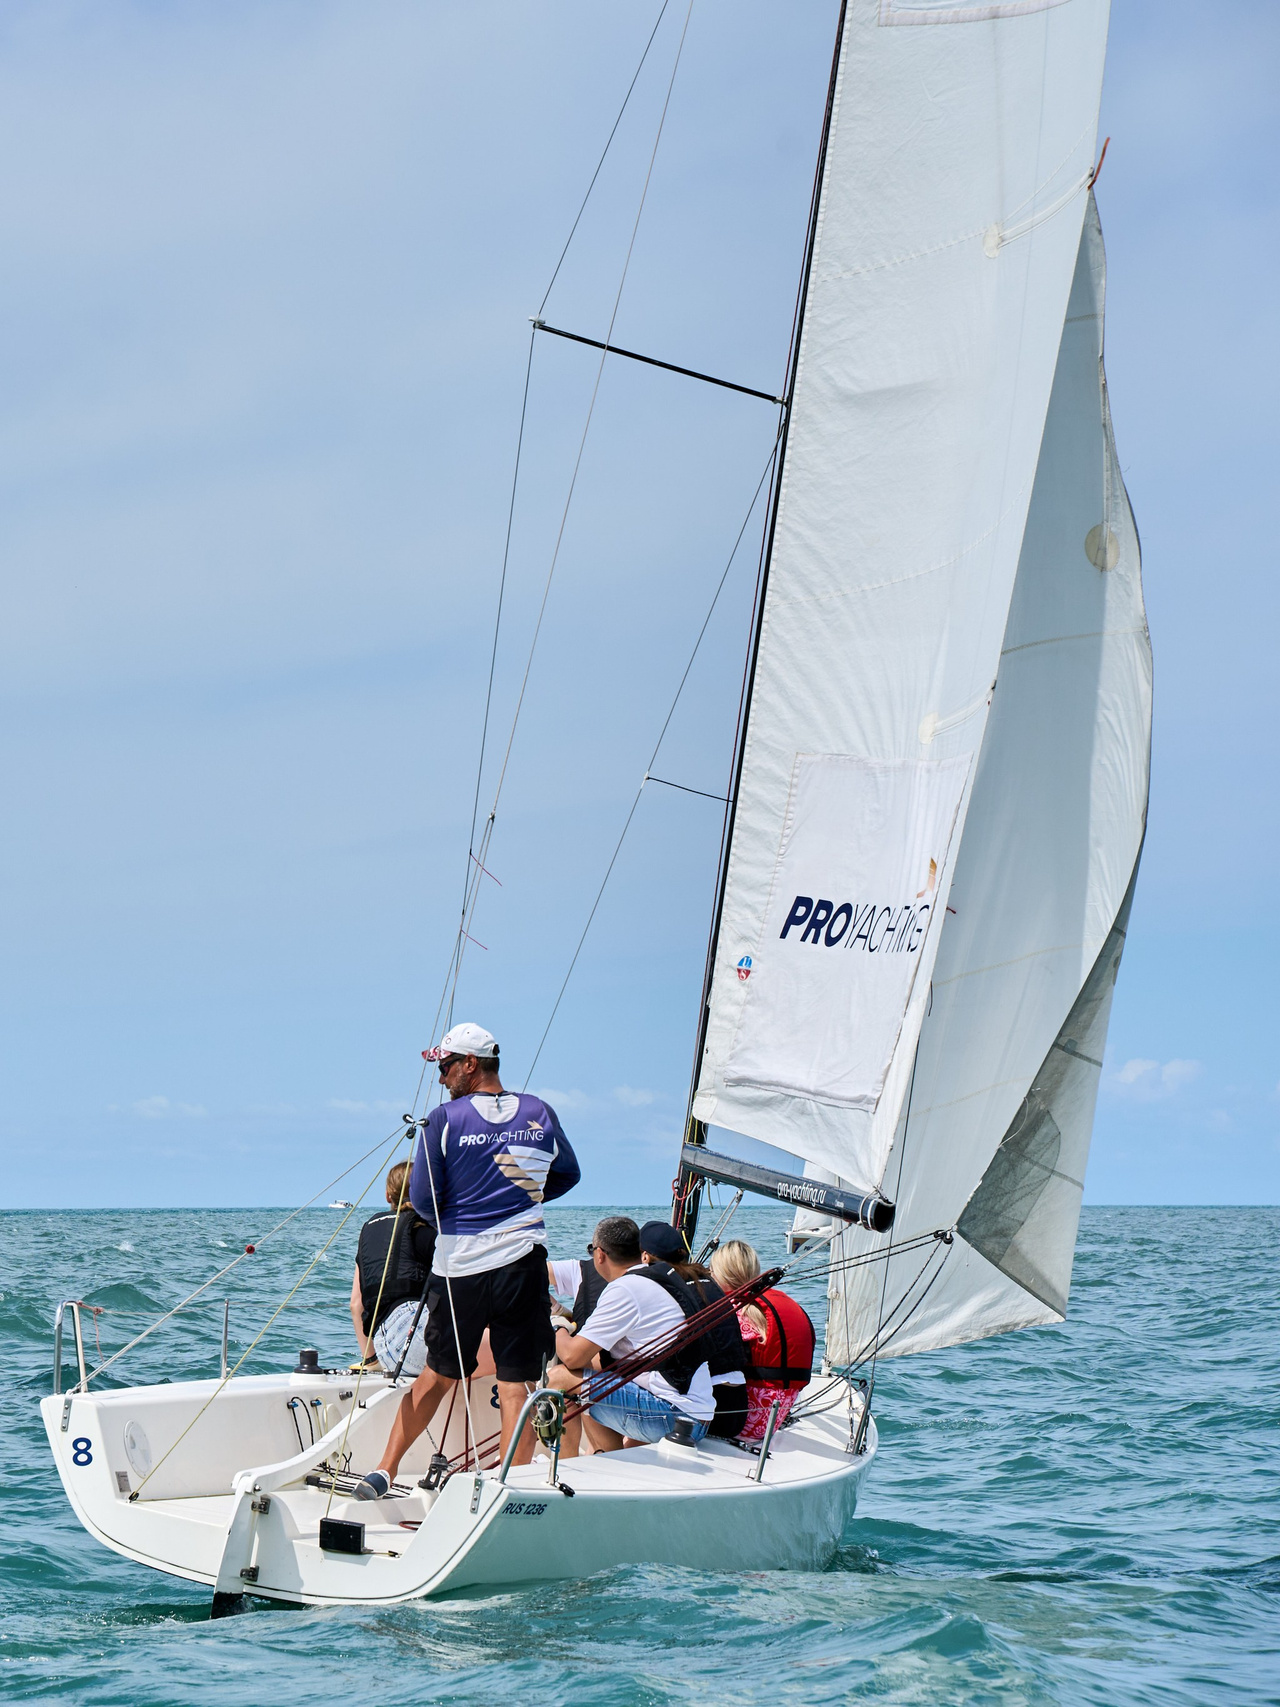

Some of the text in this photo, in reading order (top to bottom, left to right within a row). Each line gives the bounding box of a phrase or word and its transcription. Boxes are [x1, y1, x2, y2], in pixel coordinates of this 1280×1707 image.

[459, 1130, 544, 1147] PROYACHTING
[777, 1182, 827, 1207] pro-yachting.ru
[72, 1437, 93, 1467] 8
[502, 1502, 548, 1516] RUS 1236
